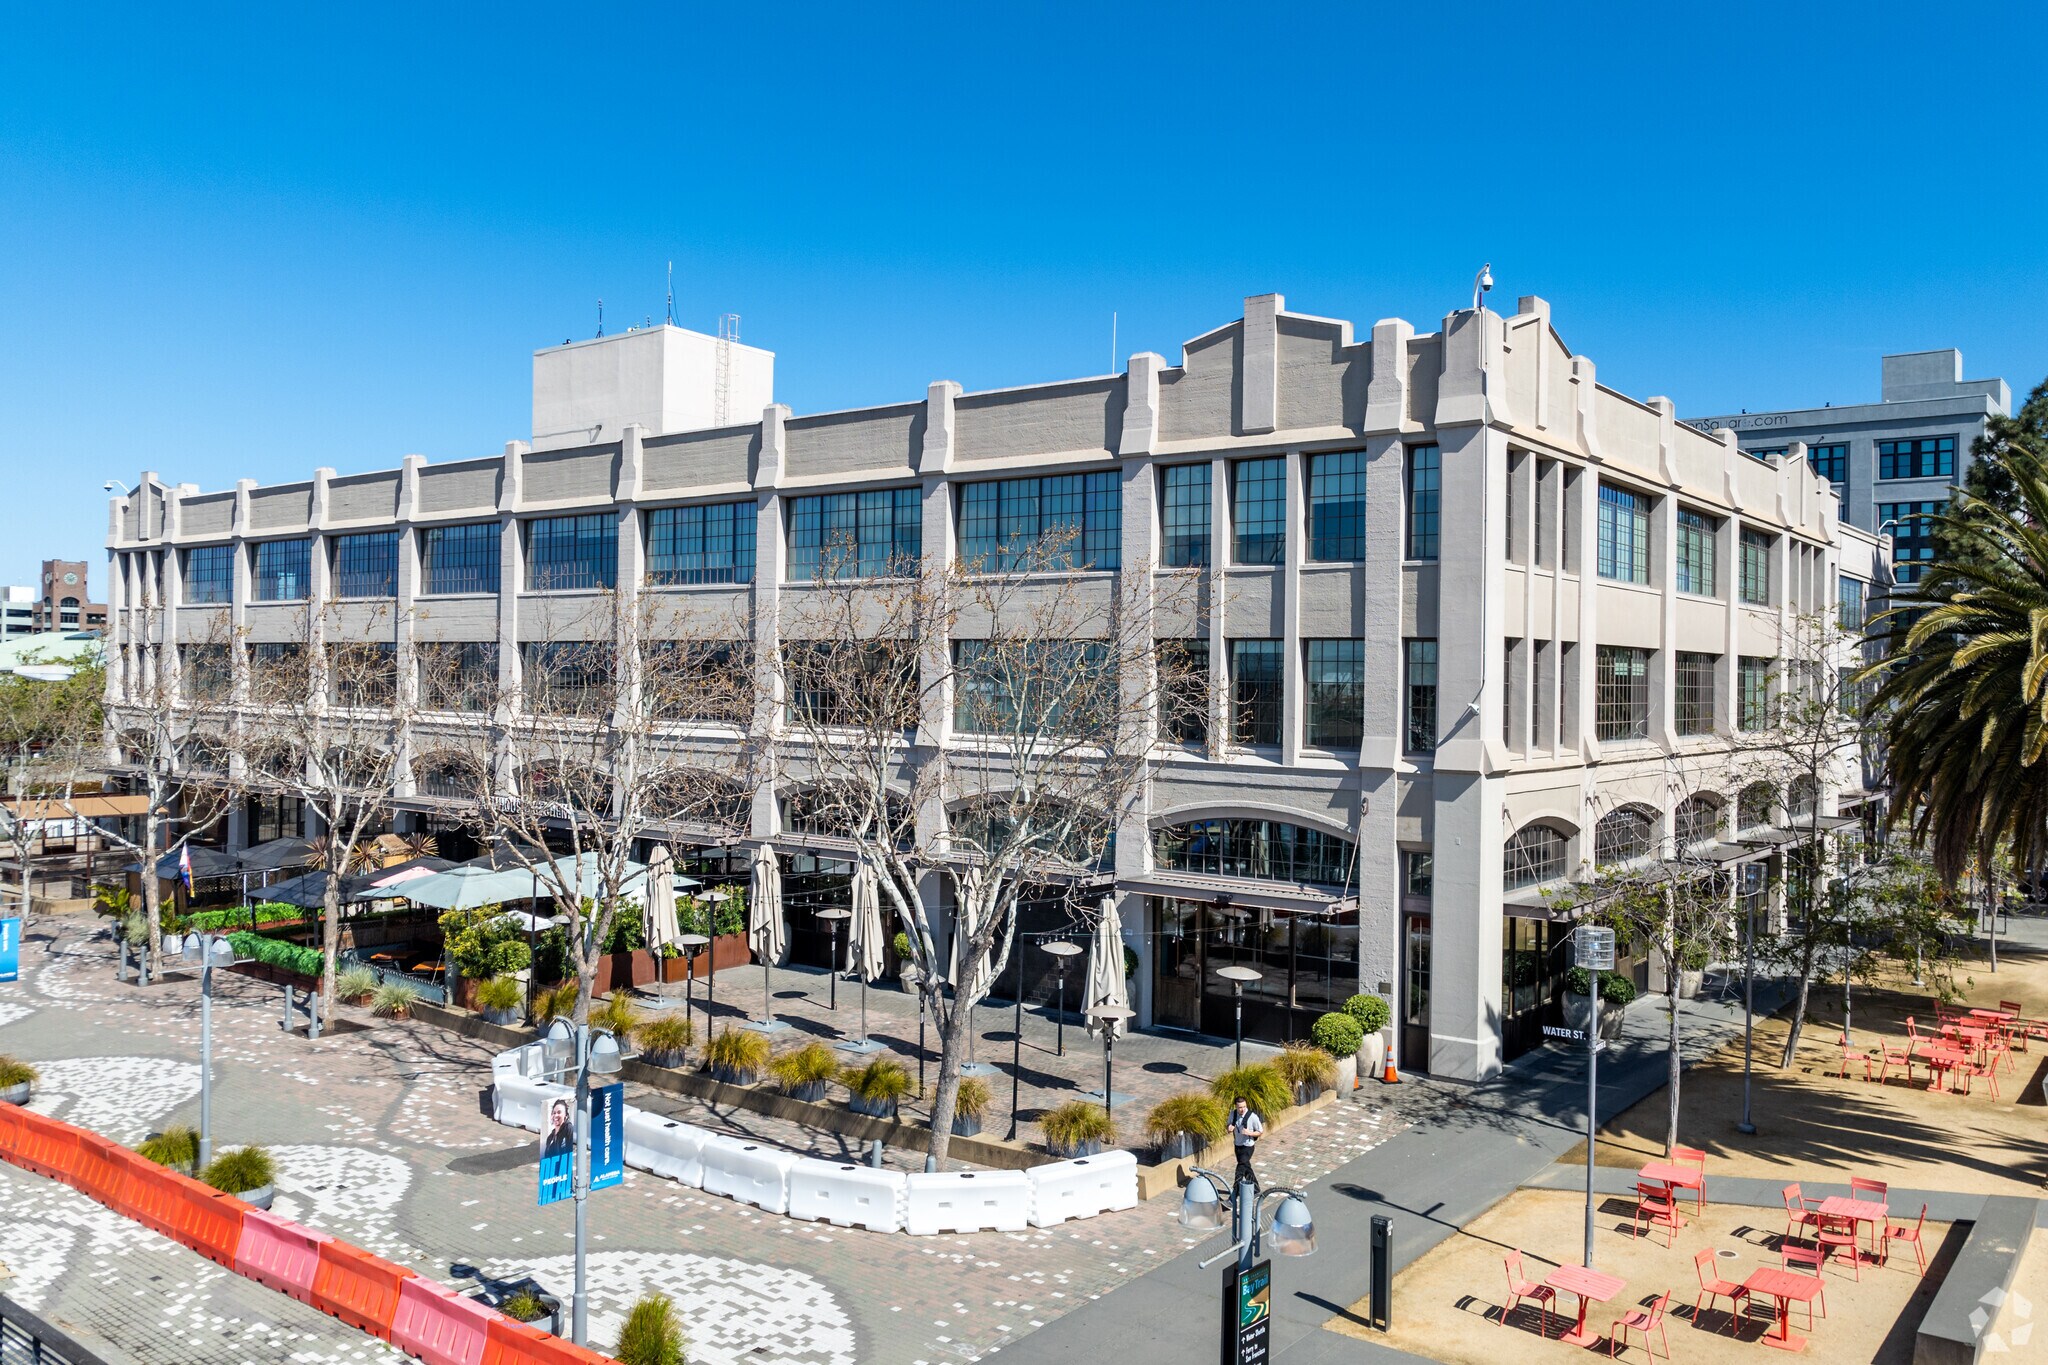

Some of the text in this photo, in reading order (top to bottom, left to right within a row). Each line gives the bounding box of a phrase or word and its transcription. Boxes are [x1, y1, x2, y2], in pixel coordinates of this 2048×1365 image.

[1542, 1025, 1586, 1040] WATER ST.
[603, 1107, 611, 1122] just
[543, 1174, 568, 1186] PEOPLE
[1242, 1283, 1254, 1296] Bay
